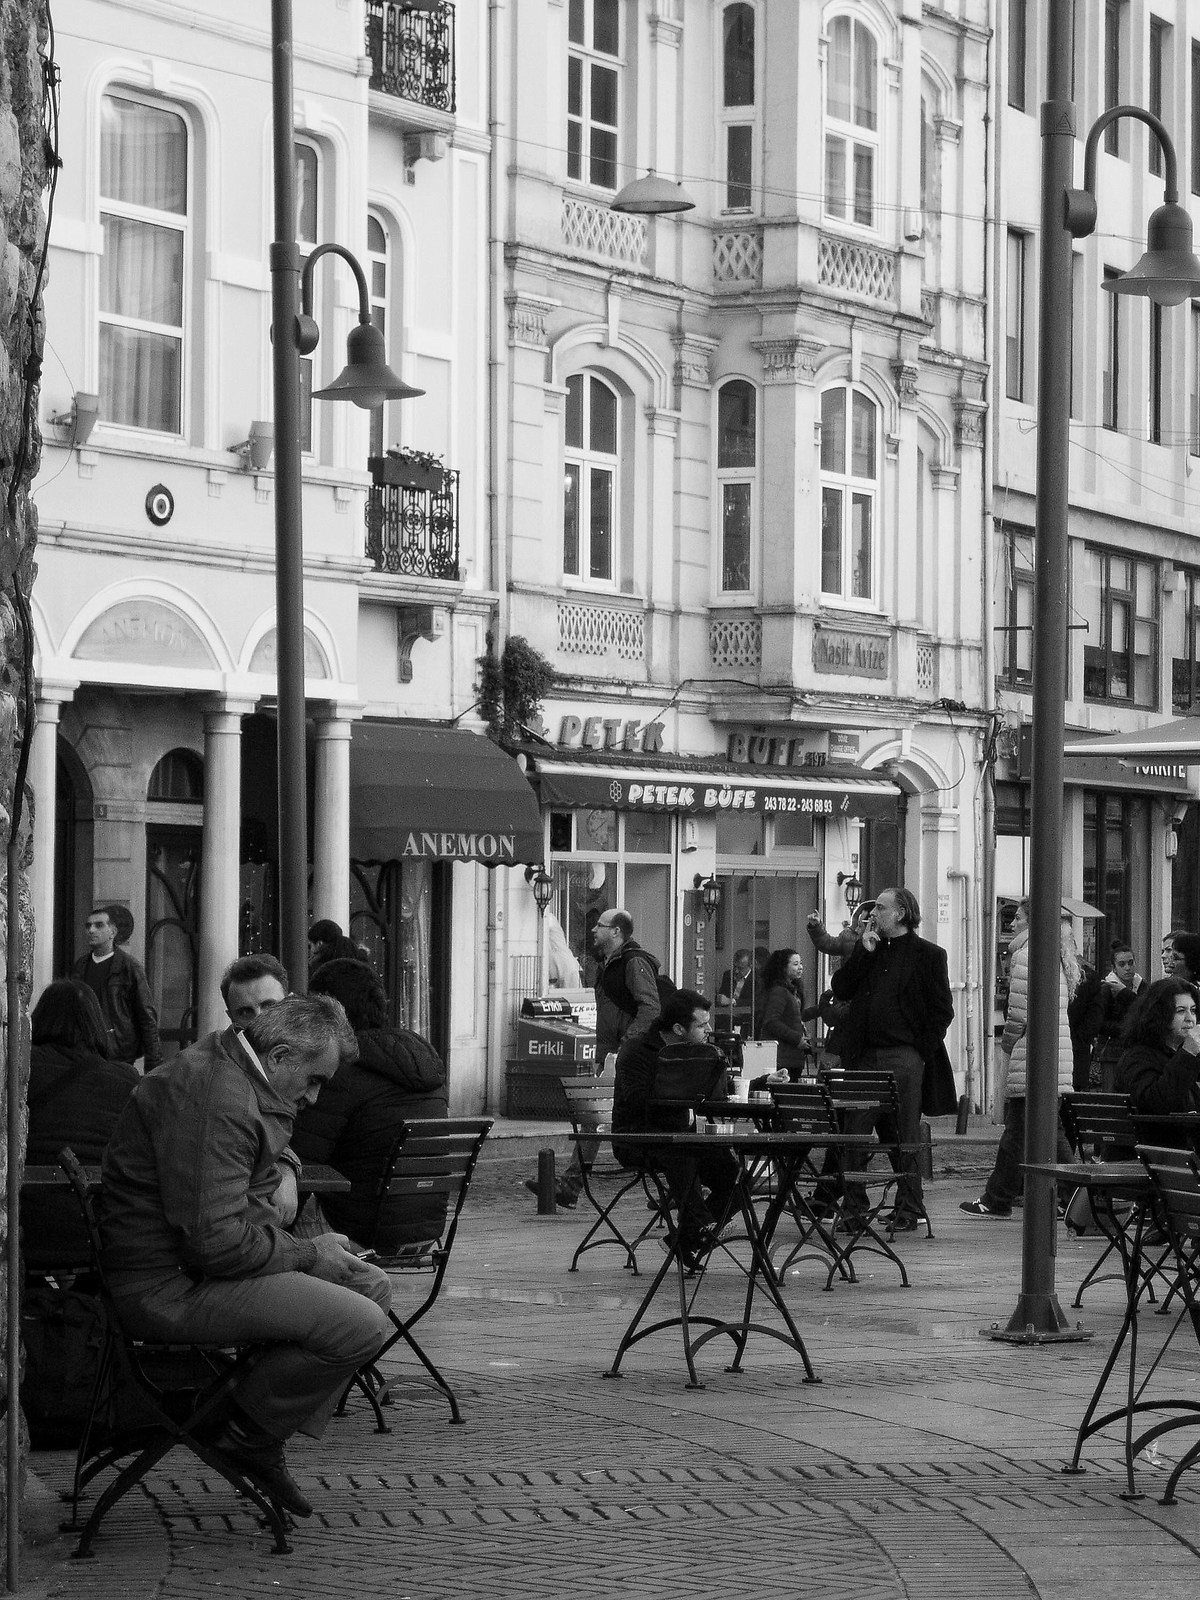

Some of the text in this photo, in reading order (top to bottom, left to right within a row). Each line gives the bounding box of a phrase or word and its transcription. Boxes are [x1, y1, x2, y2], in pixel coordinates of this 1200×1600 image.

[854, 642, 886, 670] Avize
[558, 715, 666, 751] PETEK
[628, 784, 695, 807] PETEK
[704, 783, 756, 808] BÜFE
[764, 796, 777, 811] 243
[778, 797, 787, 811] 78
[787, 797, 797, 812] 22
[801, 798, 814, 812] 243
[814, 798, 823, 813] 68
[824, 799, 833, 813] 93
[401, 832, 516, 858] ANEMON
[528, 1040, 564, 1055] Erikli
